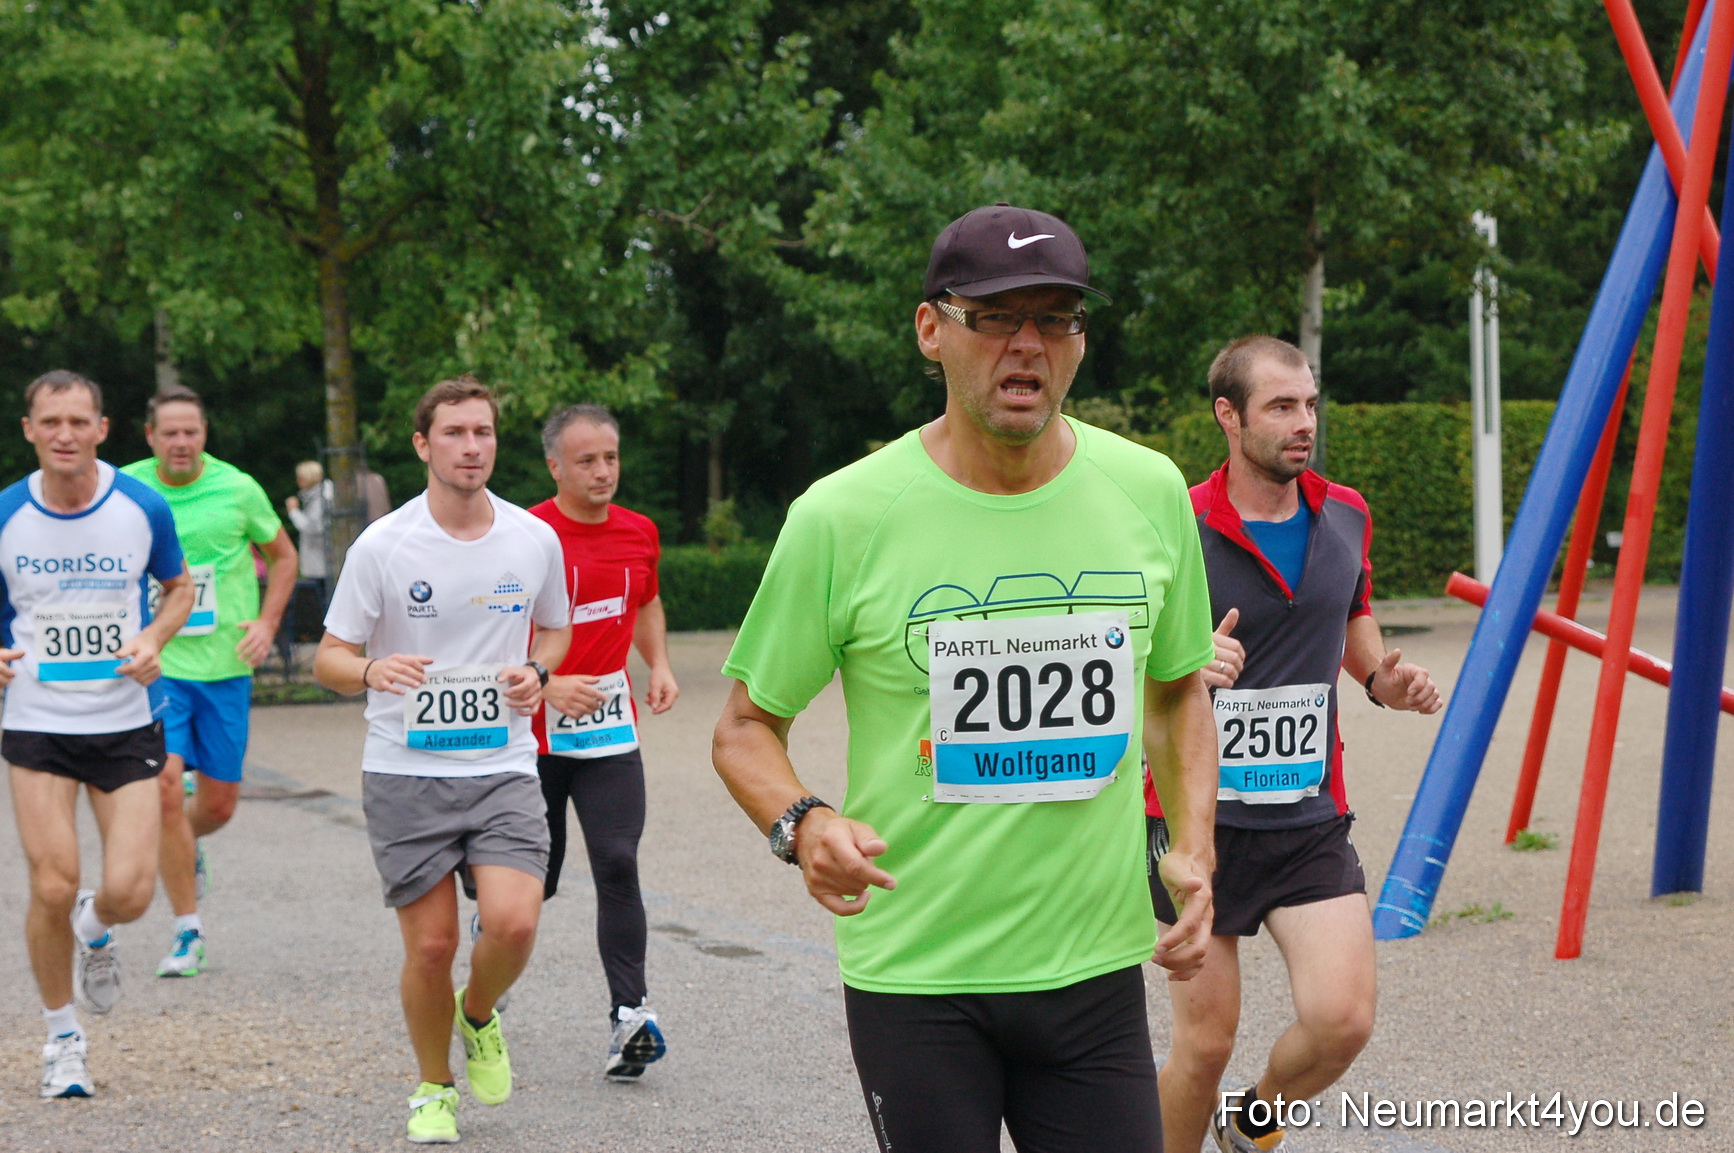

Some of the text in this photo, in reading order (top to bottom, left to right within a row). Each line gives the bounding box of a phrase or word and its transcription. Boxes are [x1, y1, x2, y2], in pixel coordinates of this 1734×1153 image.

[45, 624, 122, 657] 3093
[934, 634, 1098, 657] PARTL Neumarkt
[443, 675, 491, 685] Neumarkt
[416, 688, 499, 724] 2083
[953, 659, 1116, 733] 2028
[1216, 698, 1311, 712] PARTL Neumarkt
[424, 733, 492, 748] Alexander
[1222, 714, 1318, 759] 2502
[974, 750, 1096, 780] Wolfgang
[1244, 770, 1300, 788] Florian
